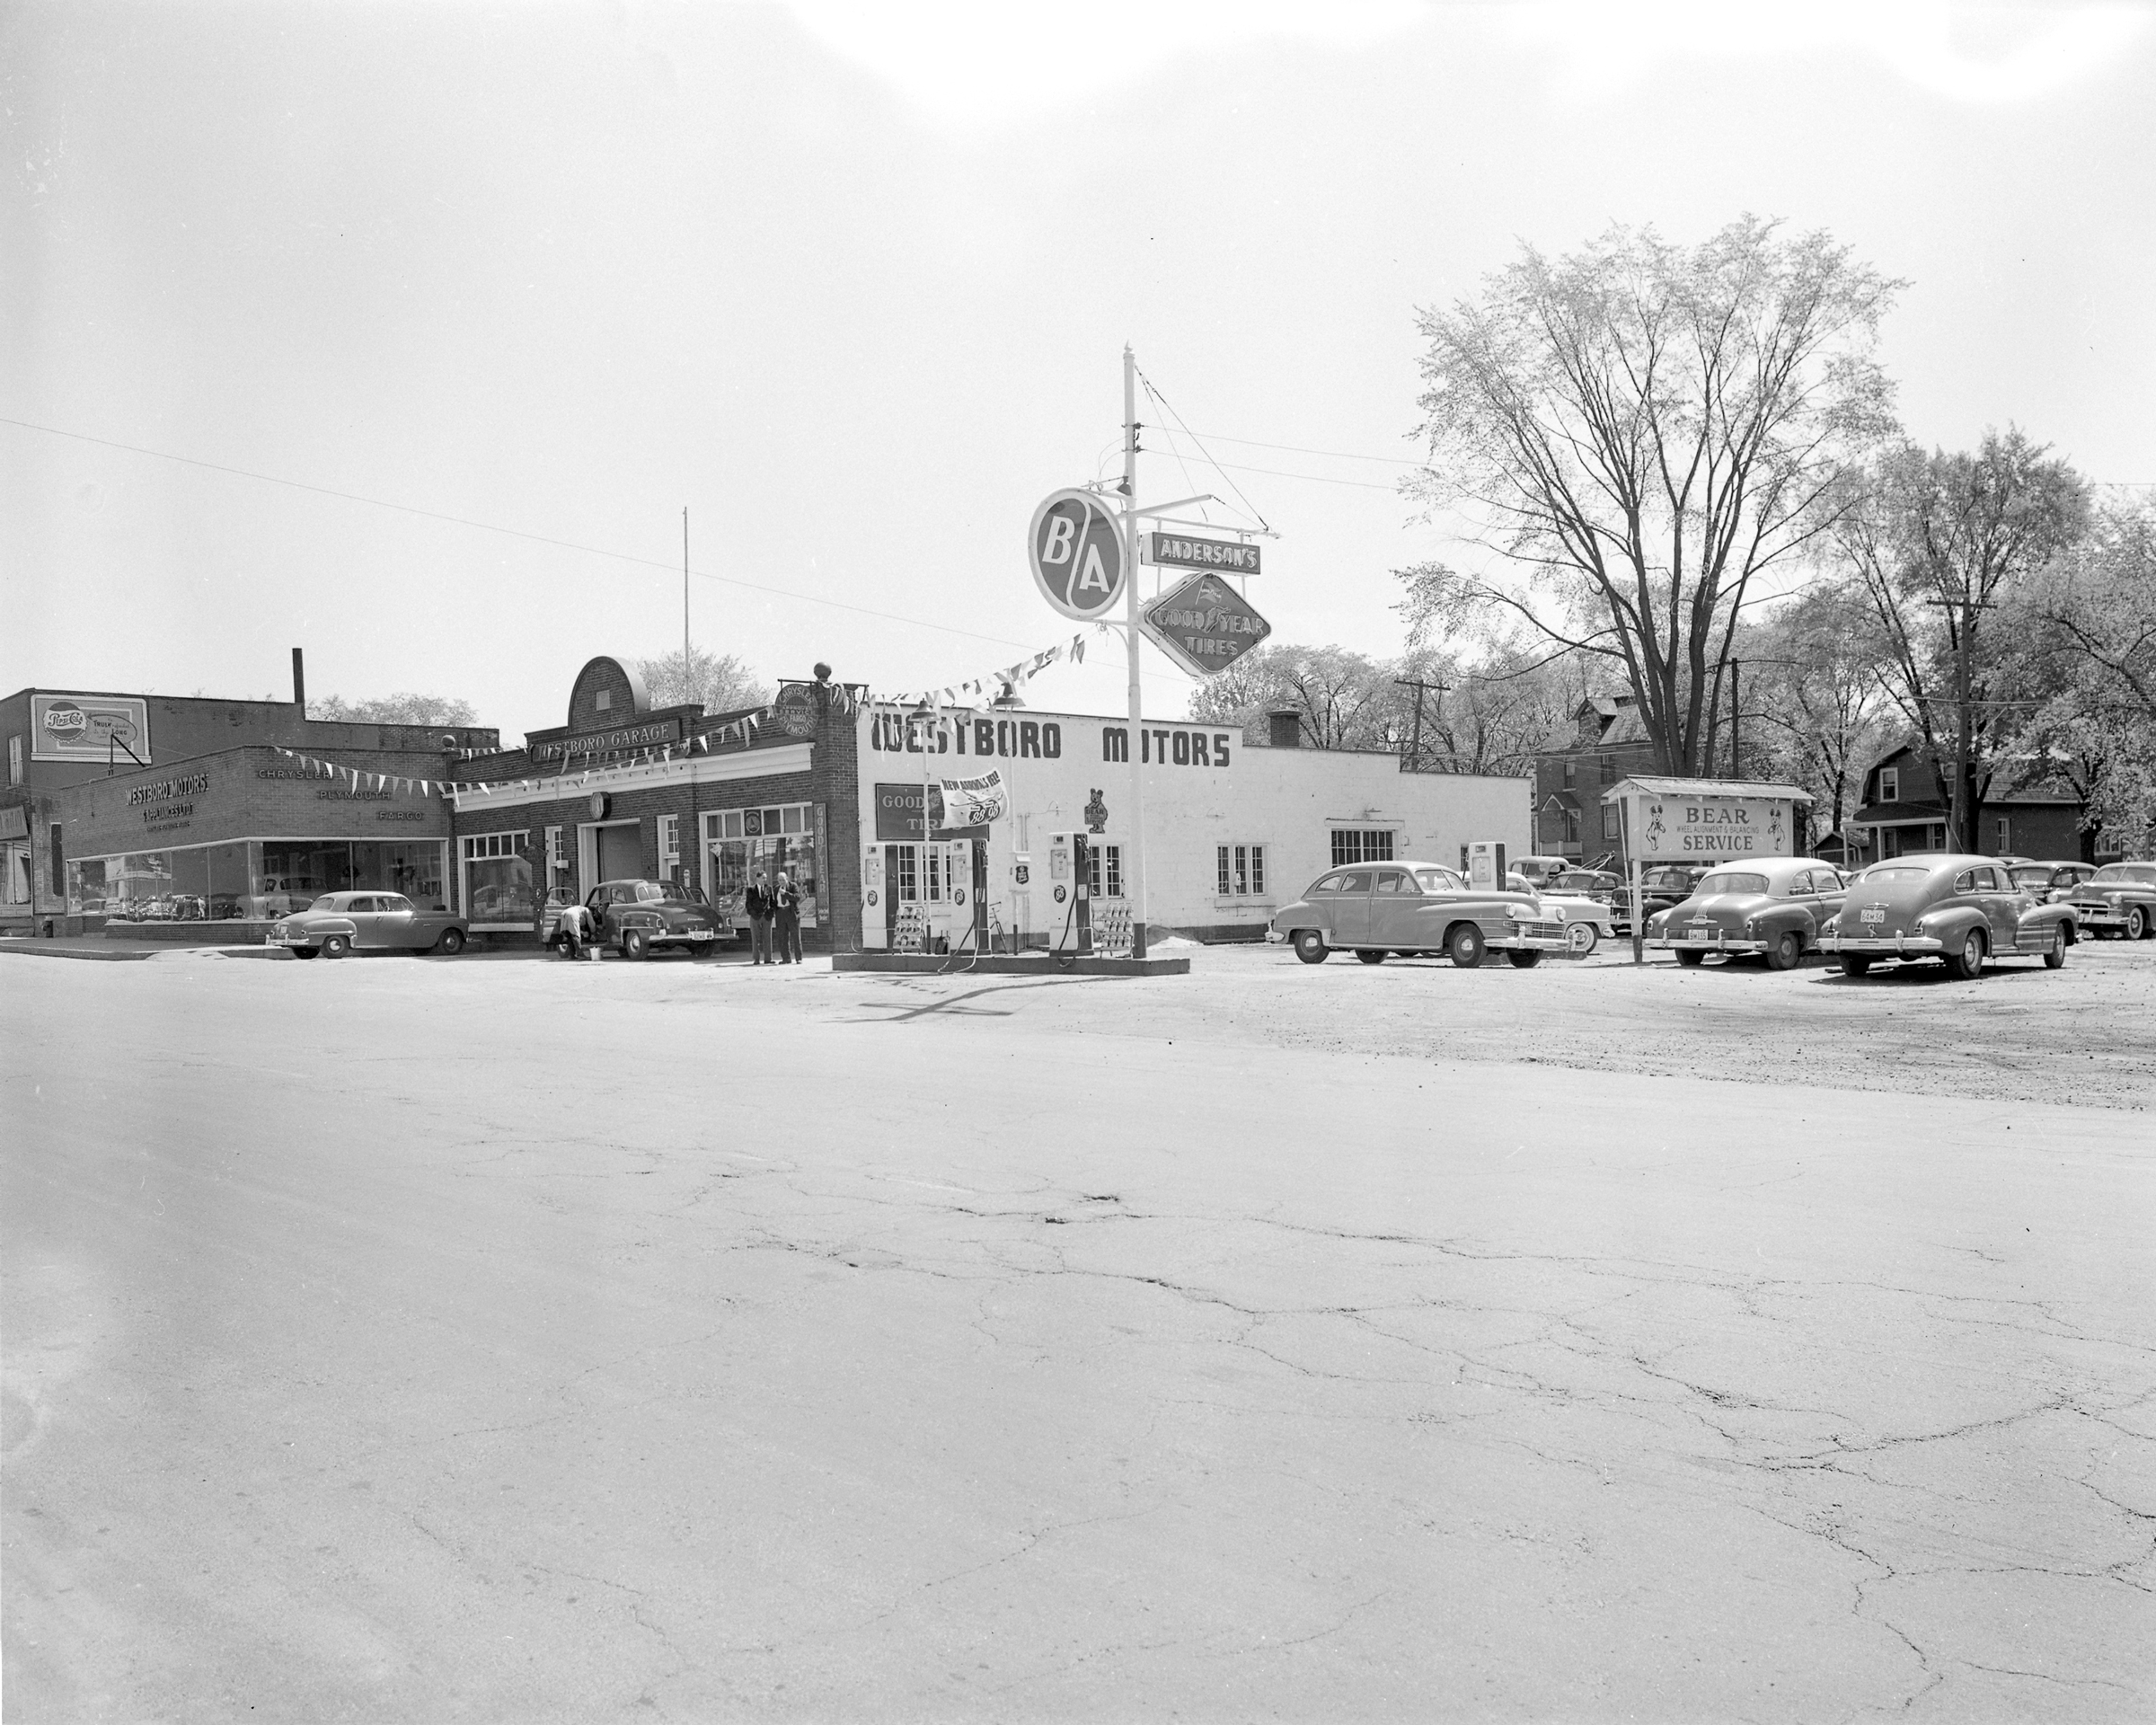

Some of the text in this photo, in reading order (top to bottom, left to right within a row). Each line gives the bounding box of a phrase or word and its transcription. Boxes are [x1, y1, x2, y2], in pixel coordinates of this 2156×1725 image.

[1161, 539, 1257, 568] ANDERSON'S
[1184, 636, 1238, 656] TIRES
[779, 686, 814, 704] CHRYSLER
[93, 720, 112, 728] TRULY
[779, 716, 816, 735] PLYMOUTH
[611, 723, 669, 747] GARAGE
[259, 769, 332, 779] CHRYSLER
[126, 773, 209, 806] WESTBORO MOTORS
[320, 791, 390, 800] PLYMOUTH
[379, 811, 422, 820] FARGO
[970, 802, 999, 824] 88 98
[1686, 807, 1750, 824] BEAR
[1676, 826, 1692, 834] WHEEL
[1693, 826, 1723, 834] ALIGNMENT
[1729, 826, 1759, 835] BALANCING
[1683, 835, 1753, 851] SERVICE
